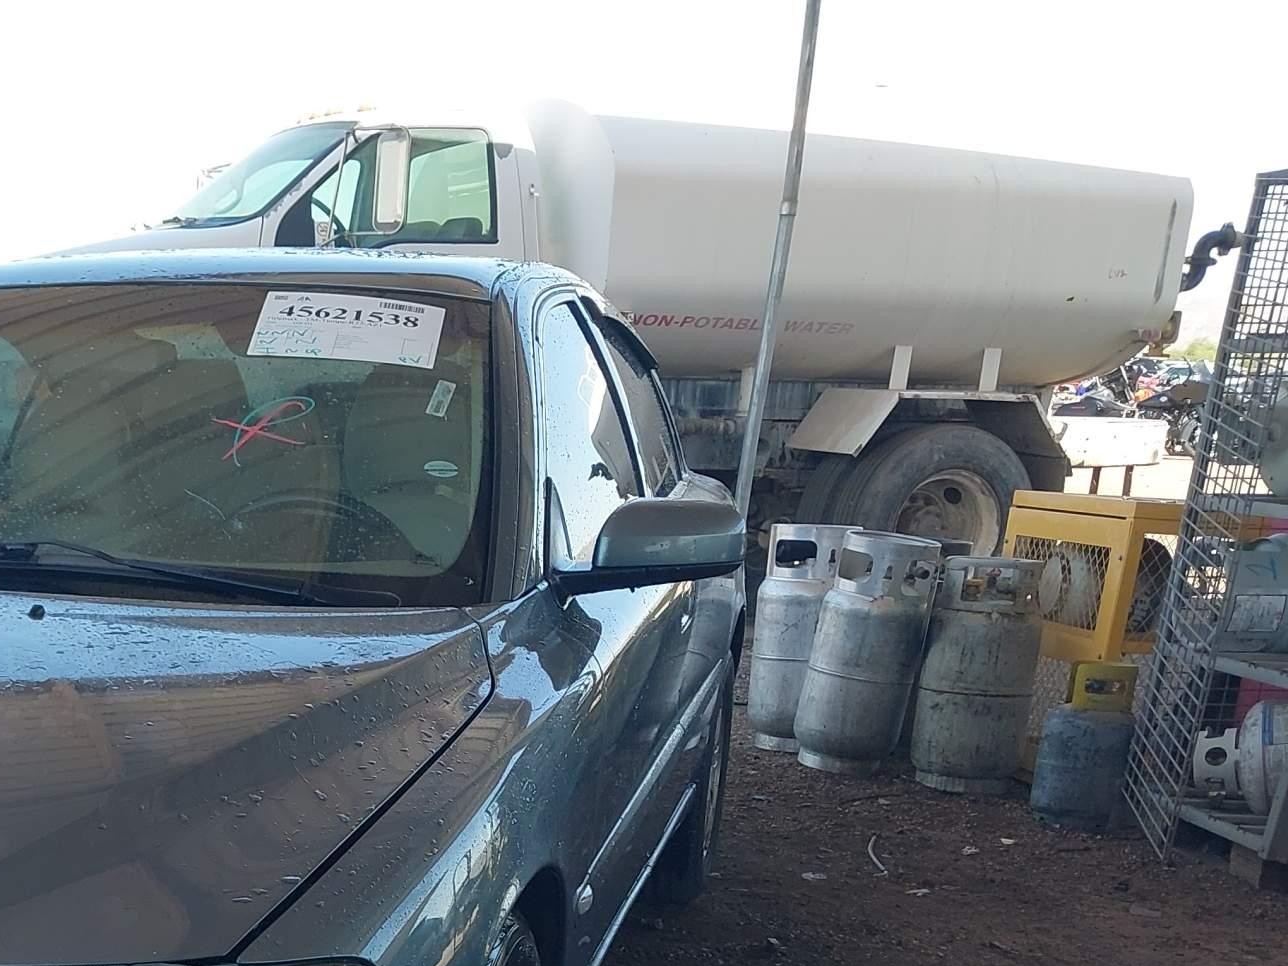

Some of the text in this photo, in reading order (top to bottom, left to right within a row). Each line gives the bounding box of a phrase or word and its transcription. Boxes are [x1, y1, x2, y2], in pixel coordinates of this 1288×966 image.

[278, 304, 420, 328] 45621538
[632, 313, 854, 335] NON-POTABL WATER
